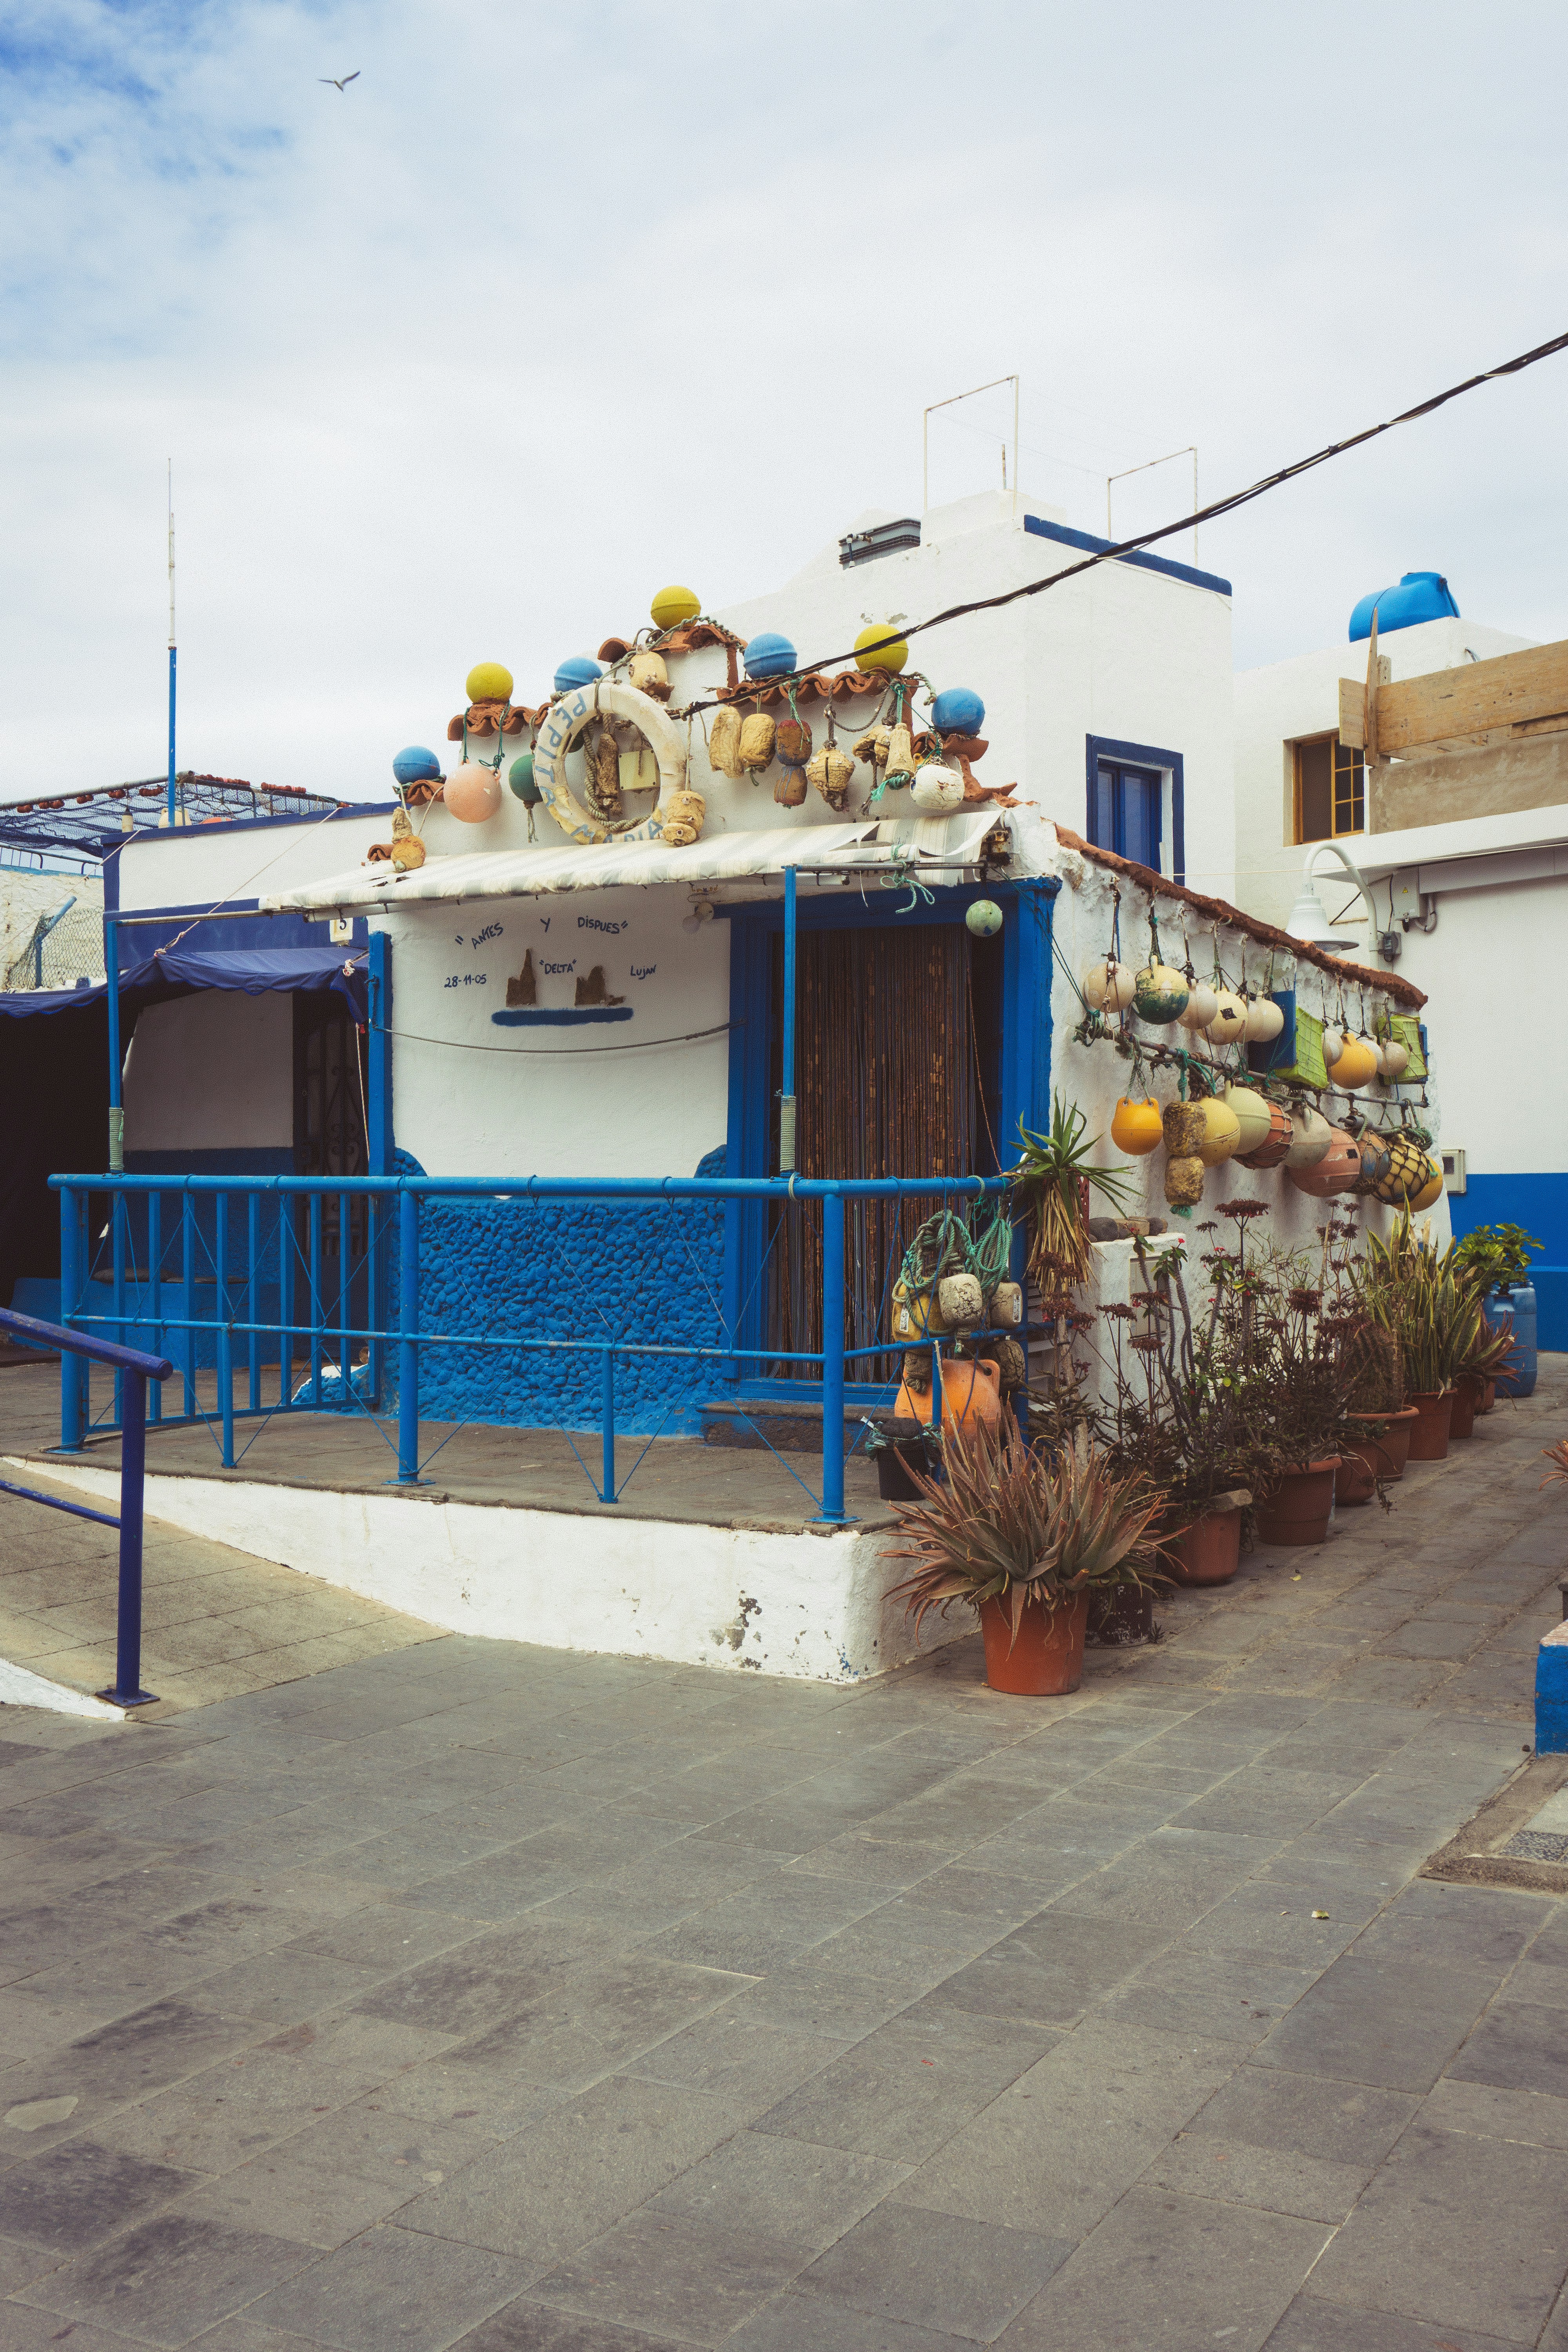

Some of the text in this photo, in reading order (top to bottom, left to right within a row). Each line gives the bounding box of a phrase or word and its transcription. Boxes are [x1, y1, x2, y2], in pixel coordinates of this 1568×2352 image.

[534, 693, 587, 807] PEPITA
[540, 917, 551, 933] Y
[539, 959, 577, 975] "DELTA"
[443, 973, 487, 988] 28-11-05
